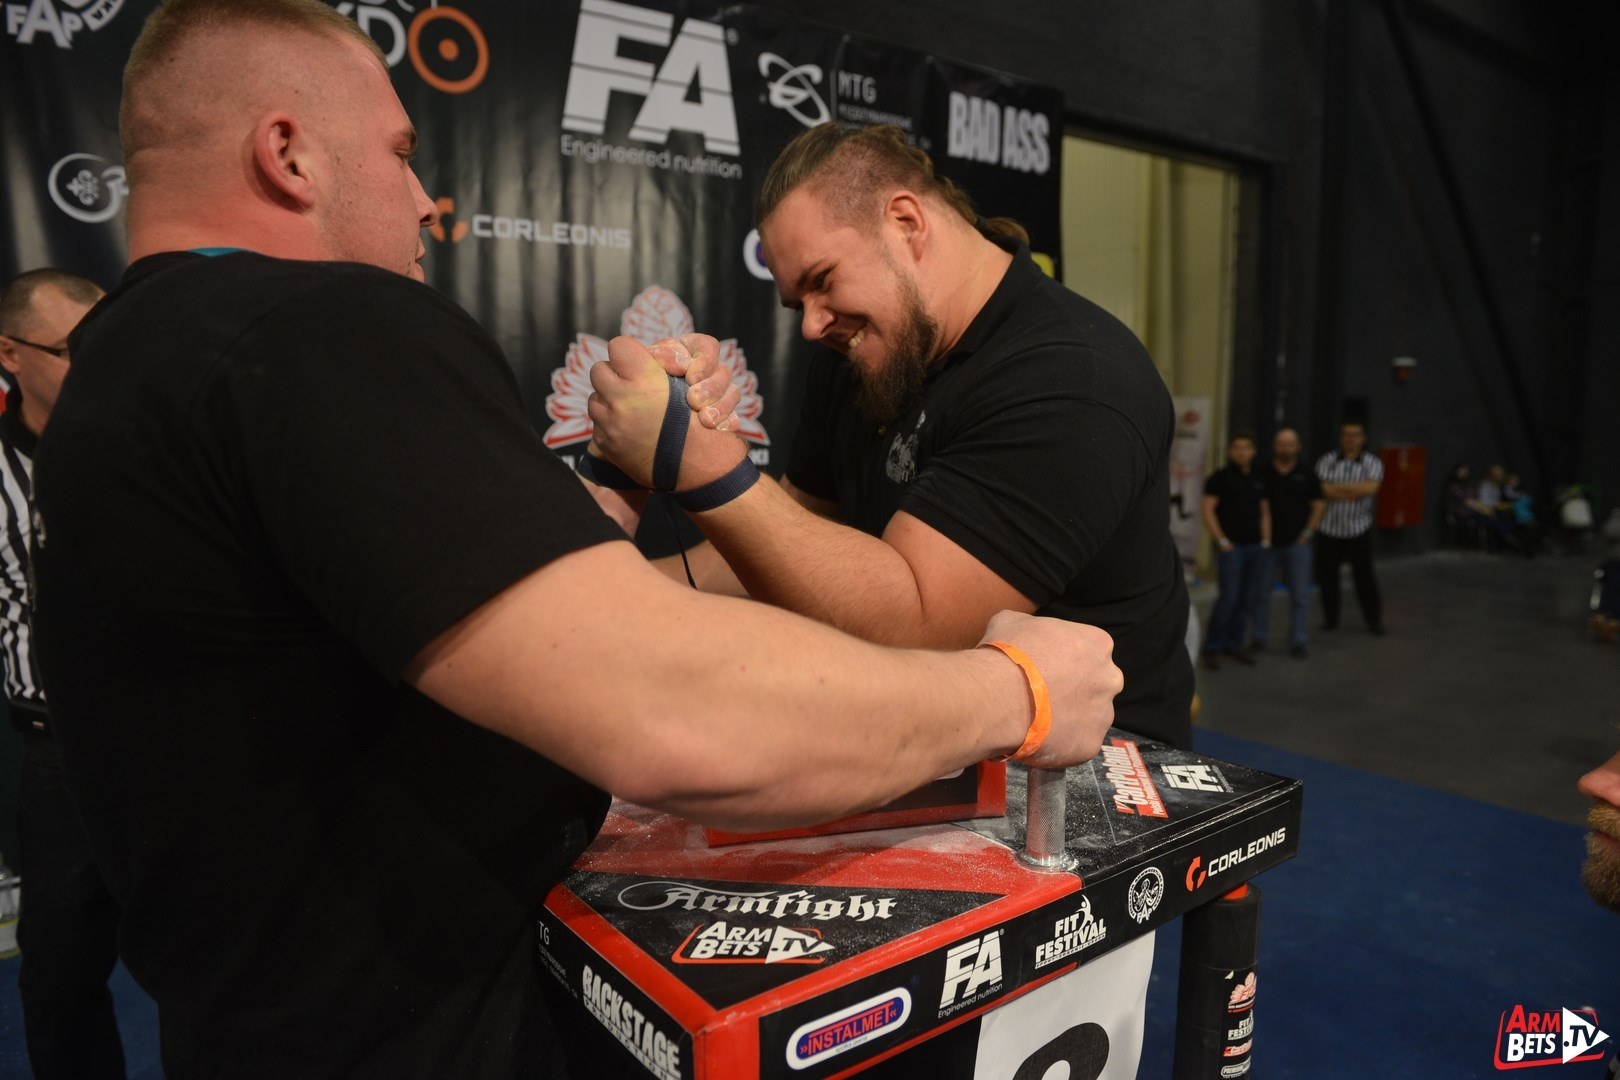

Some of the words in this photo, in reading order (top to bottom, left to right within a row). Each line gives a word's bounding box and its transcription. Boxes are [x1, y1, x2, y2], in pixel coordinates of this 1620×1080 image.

[6, 0, 83, 49] FAP
[562, 0, 741, 156] FA
[838, 69, 877, 104] MTG
[948, 91, 1000, 164] BAD
[1002, 105, 1050, 174] ASS
[560, 134, 671, 170] Engineered
[673, 153, 743, 180] nutrition
[472, 214, 632, 249] CORLEONIS
[1208, 827, 1286, 877] CORLEONIS
[617, 881, 898, 921] Armfight
[1136, 902, 1153, 924] FAP
[538, 921, 549, 945] TG
[697, 921, 771, 942] ARM
[1036, 918, 1107, 963] FESTIVAL
[1055, 912, 1080, 938] FIT
[690, 939, 763, 959] BETS
[939, 930, 1003, 1009] FA
[938, 996, 977, 1018] Engineered
[977, 983, 1003, 1000] nutrition
[582, 965, 681, 1080] BACKSTAGE
